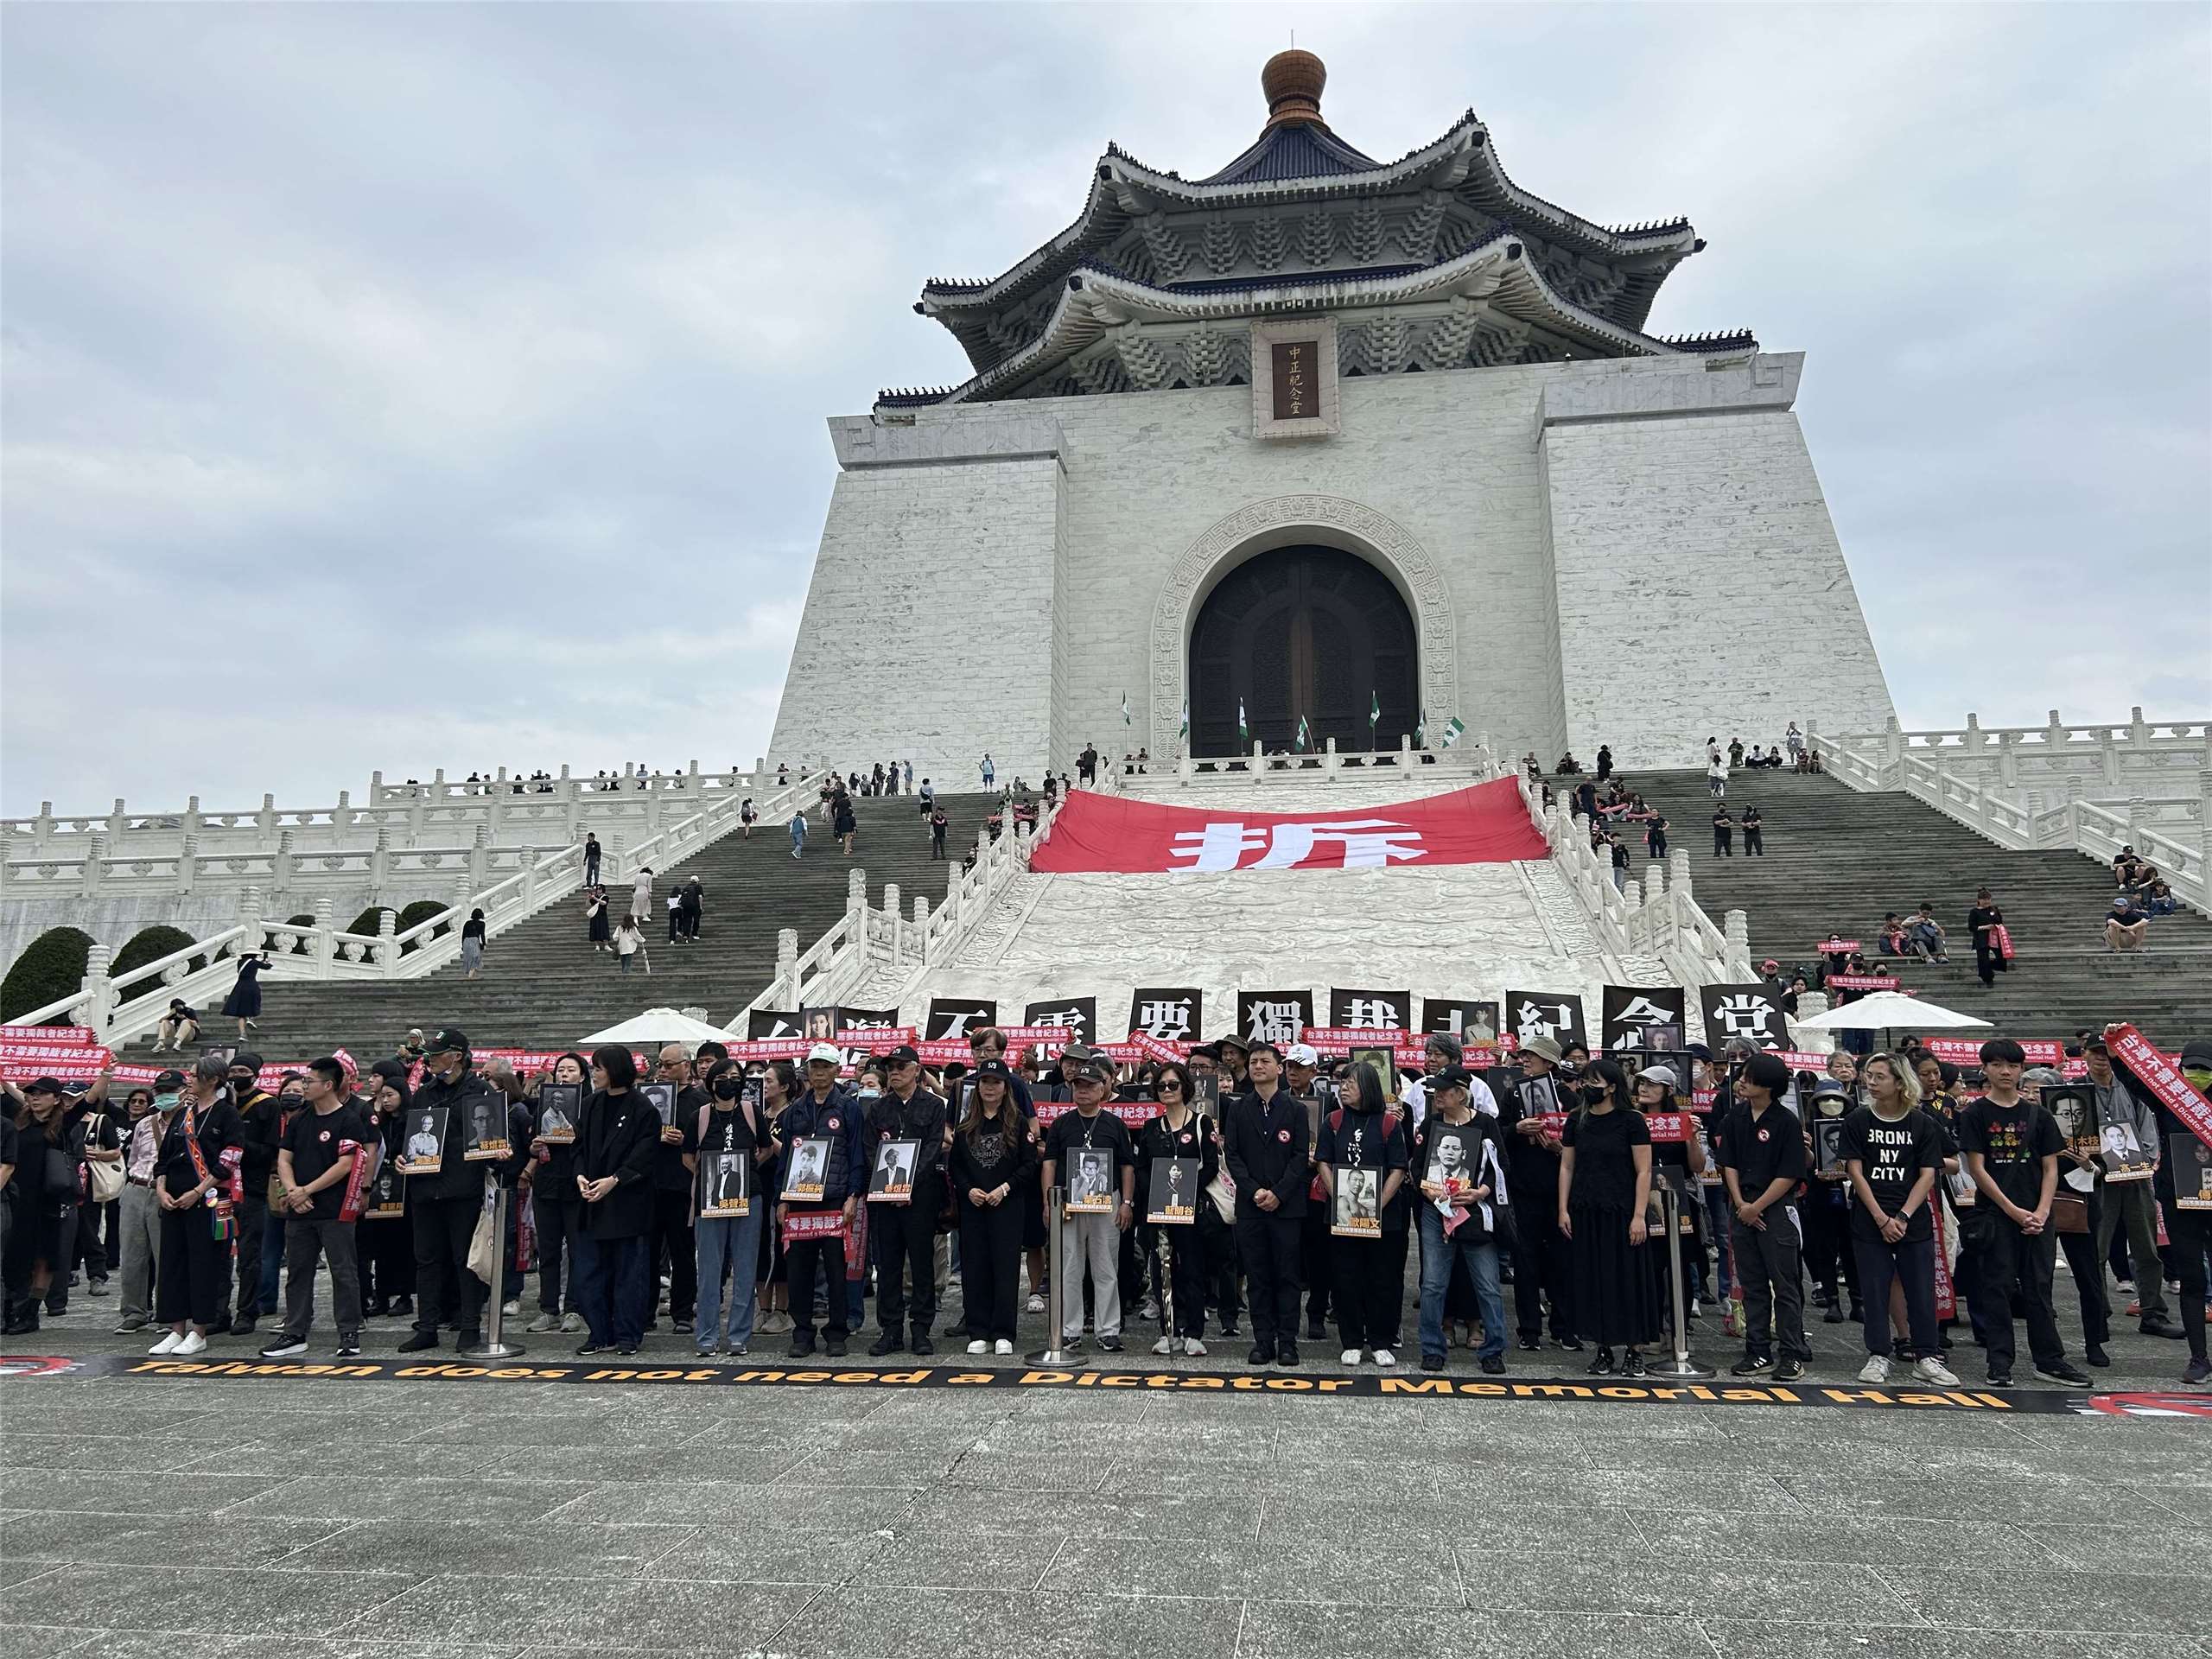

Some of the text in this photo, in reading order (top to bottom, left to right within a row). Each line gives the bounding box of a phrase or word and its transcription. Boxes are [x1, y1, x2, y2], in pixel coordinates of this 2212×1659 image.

[1288, 346, 1303, 415] 中正紀念堂
[0, 1028, 89, 1039] 需要獨裁者紀念堂
[1136, 997, 1192, 1042] 要
[1246, 1000, 1305, 1045] 獨
[1516, 1000, 1573, 1045] 紀
[1713, 994, 1779, 1051] 堂
[2114, 1042, 2135, 1065] Taiwan
[2133, 1062, 2148, 1079] does
[2147, 1077, 2159, 1090] not
[2158, 1085, 2174, 1104] need
[2177, 1106, 2202, 1131] Dictator
[1871, 1166, 1905, 1182] CITY
[1879, 1148, 1900, 1164] NY
[785, 1216, 843, 1231] 需要獨裁者
[127, 1361, 2013, 1409] Taiwan does not need a Dictator Memorial Hall
